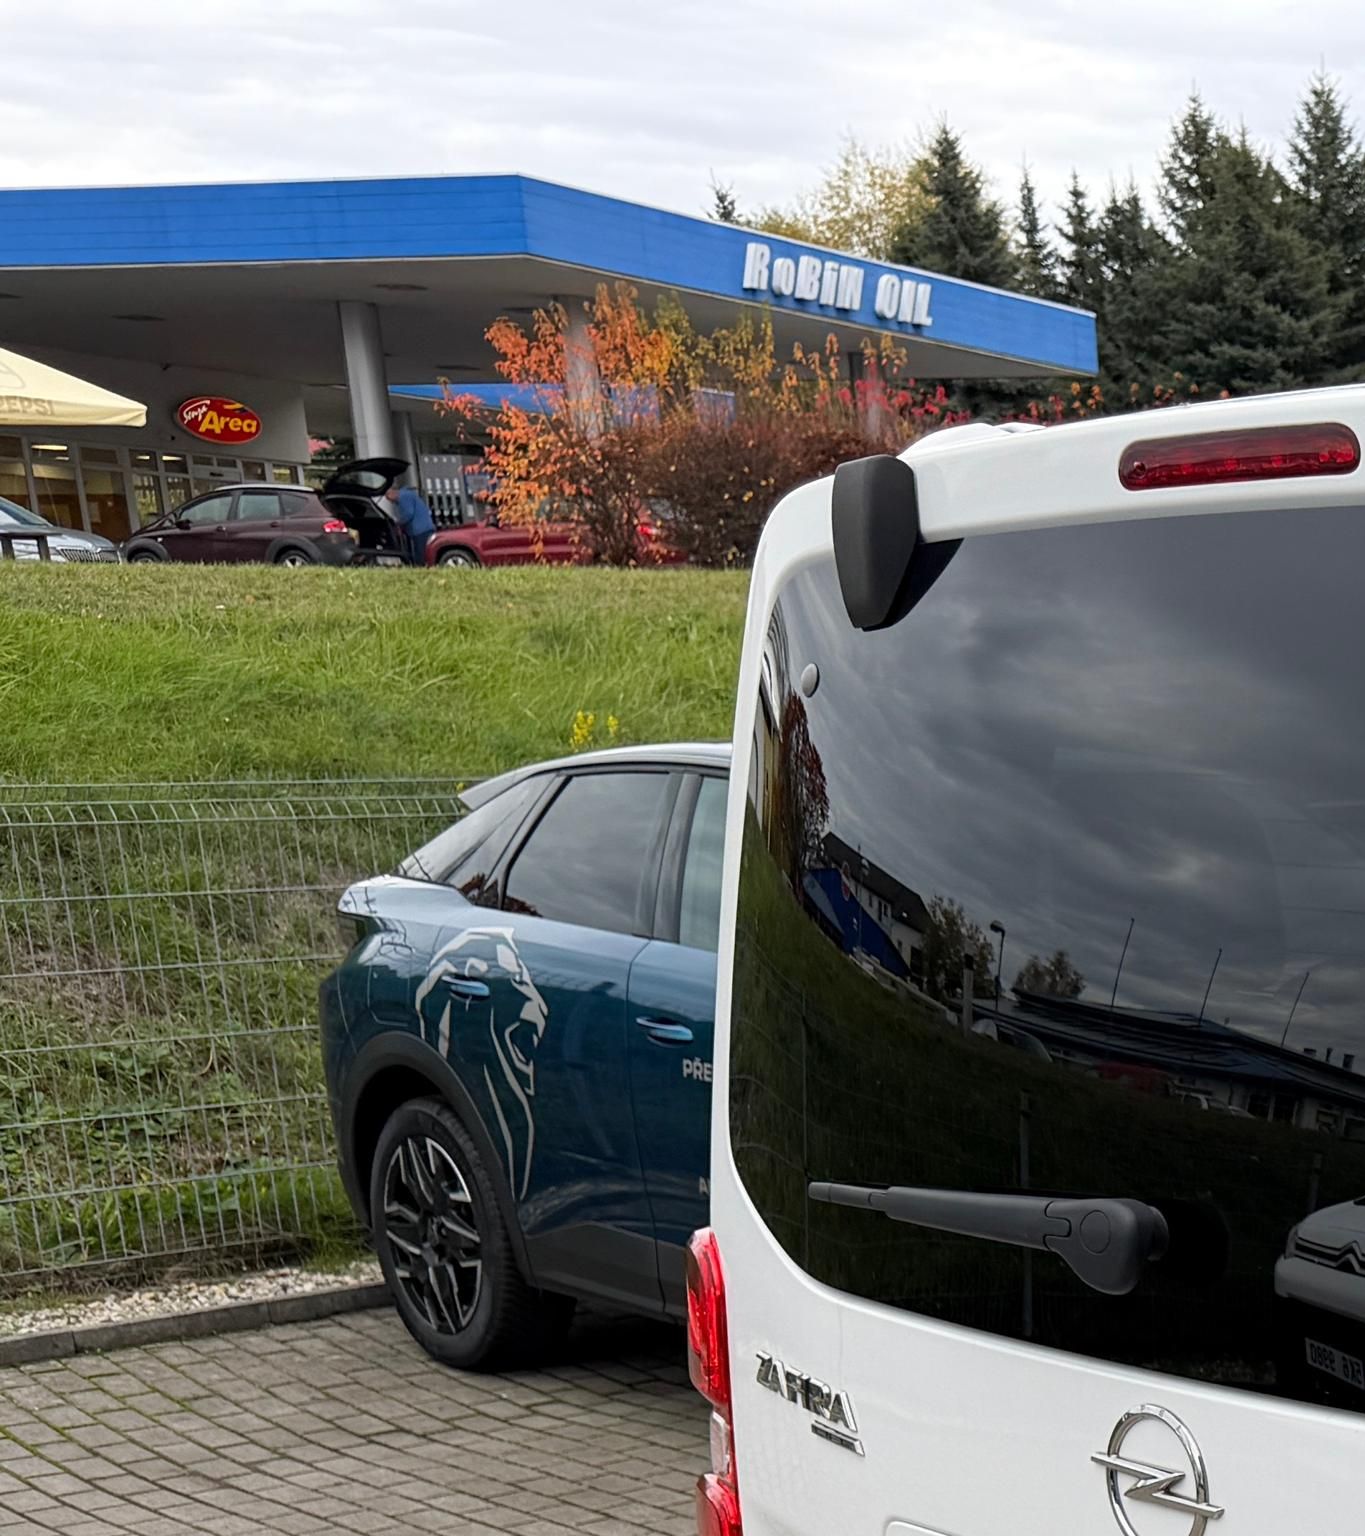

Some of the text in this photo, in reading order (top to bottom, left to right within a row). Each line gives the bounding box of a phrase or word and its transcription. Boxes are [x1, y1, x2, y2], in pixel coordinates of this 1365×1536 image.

[874, 273, 934, 327] OIL
[198, 410, 258, 434] Area
[755, 1349, 859, 1434] ZAFIRA
